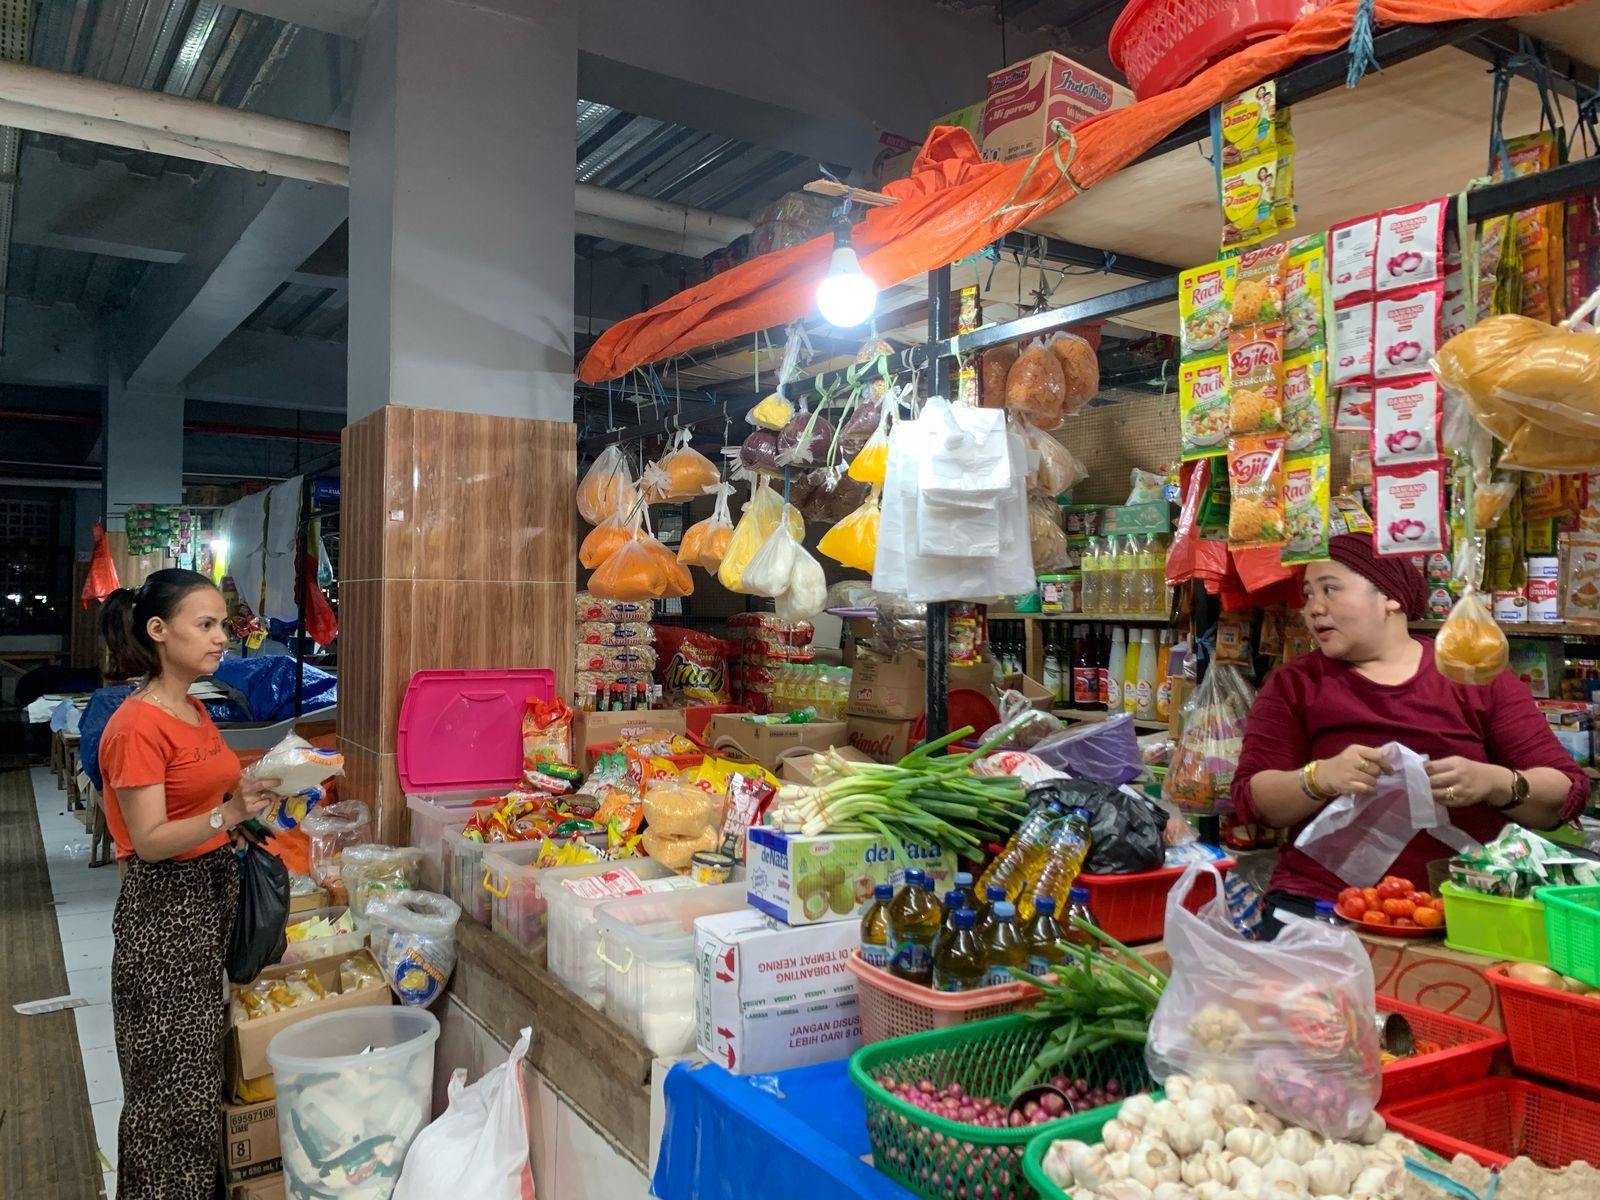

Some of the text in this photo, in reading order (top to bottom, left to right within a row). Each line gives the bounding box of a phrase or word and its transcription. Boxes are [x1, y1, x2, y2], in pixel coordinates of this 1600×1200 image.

[1238, 265, 1280, 280] ERBAGUNA
[1192, 278, 1225, 306] Racik
[1284, 272, 1306, 296] acik
[1231, 347, 1280, 376] Sajiku
[1192, 373, 1225, 400] Racik
[761, 847, 789, 871] deNata
[757, 957, 797, 973] KERING
[799, 952, 835, 967] TEMPAT
[776, 965, 830, 983] DIBANTING
[789, 1015, 862, 1037] JANGAN DISUS
[788, 1035, 819, 1049] LEBIH
[820, 1030, 844, 1043] DARI
[231, 1123, 249, 1135] LIME
[236, 1142, 246, 1157] 8
